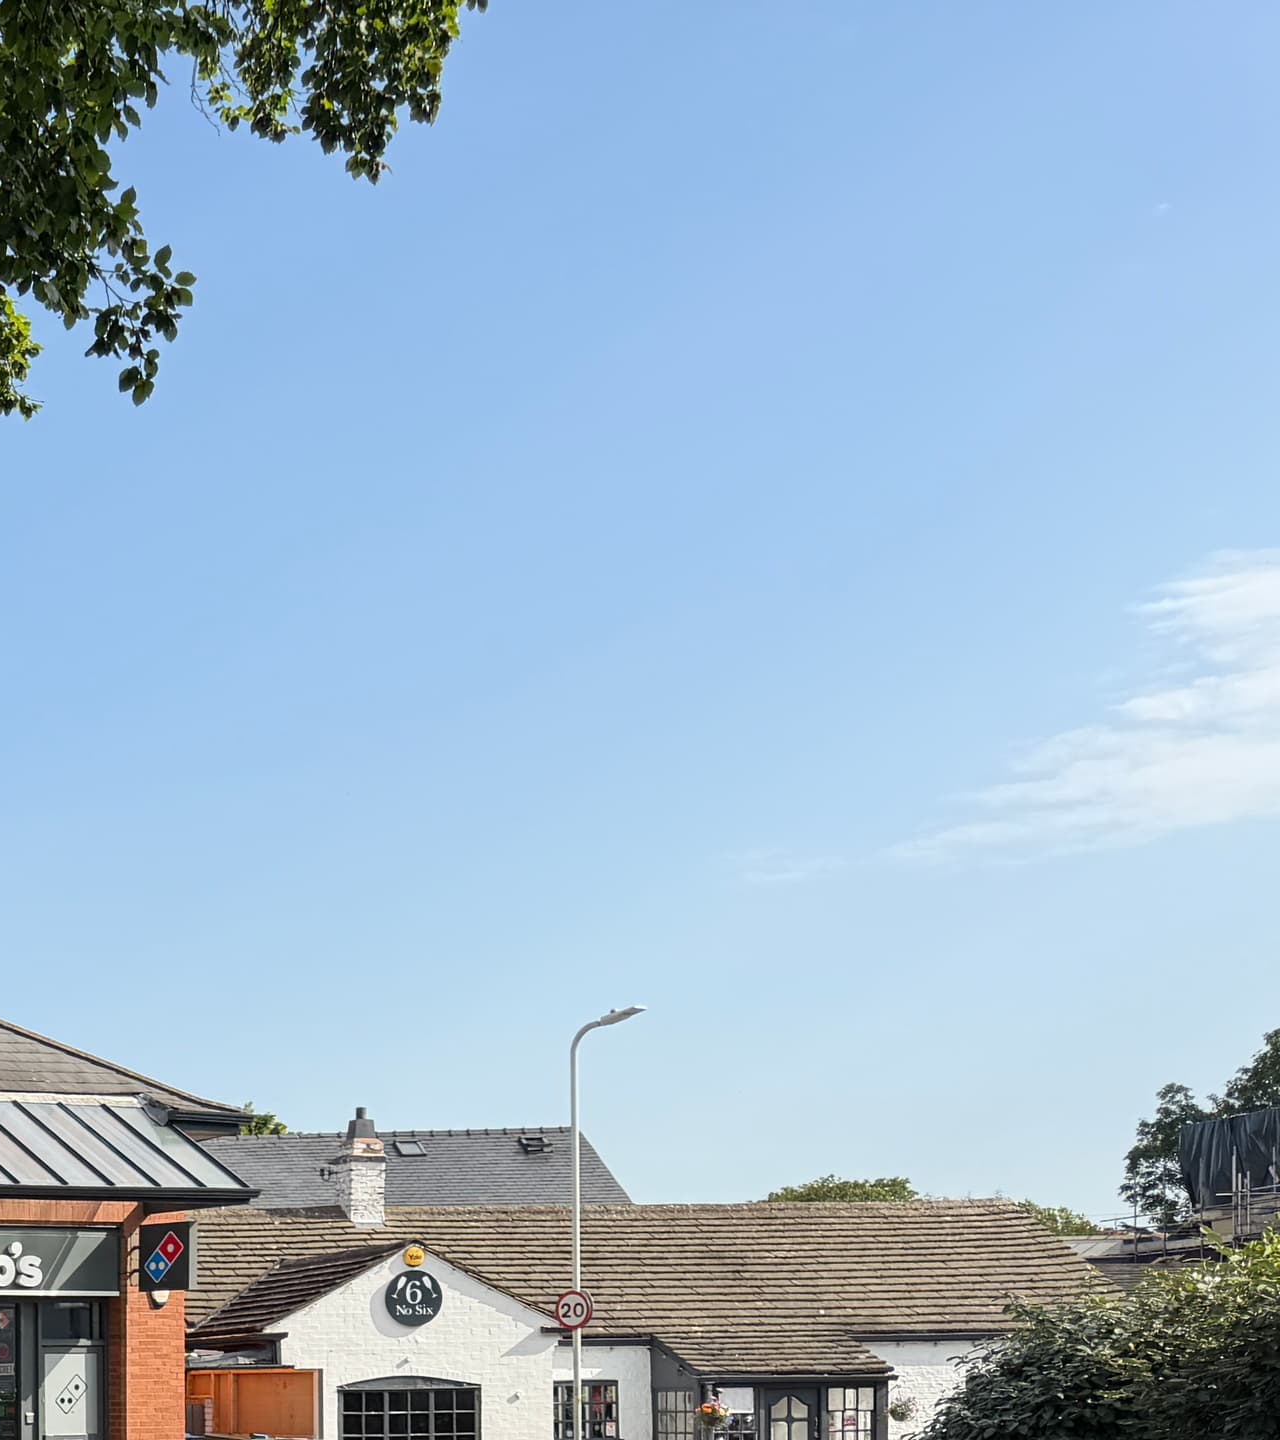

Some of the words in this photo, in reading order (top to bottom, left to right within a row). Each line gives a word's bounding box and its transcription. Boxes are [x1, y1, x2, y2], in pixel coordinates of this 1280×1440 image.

[405, 1280, 423, 1305] 6
[396, 1305, 413, 1316] No
[415, 1305, 434, 1315] Six
[560, 1302, 585, 1318] 20
